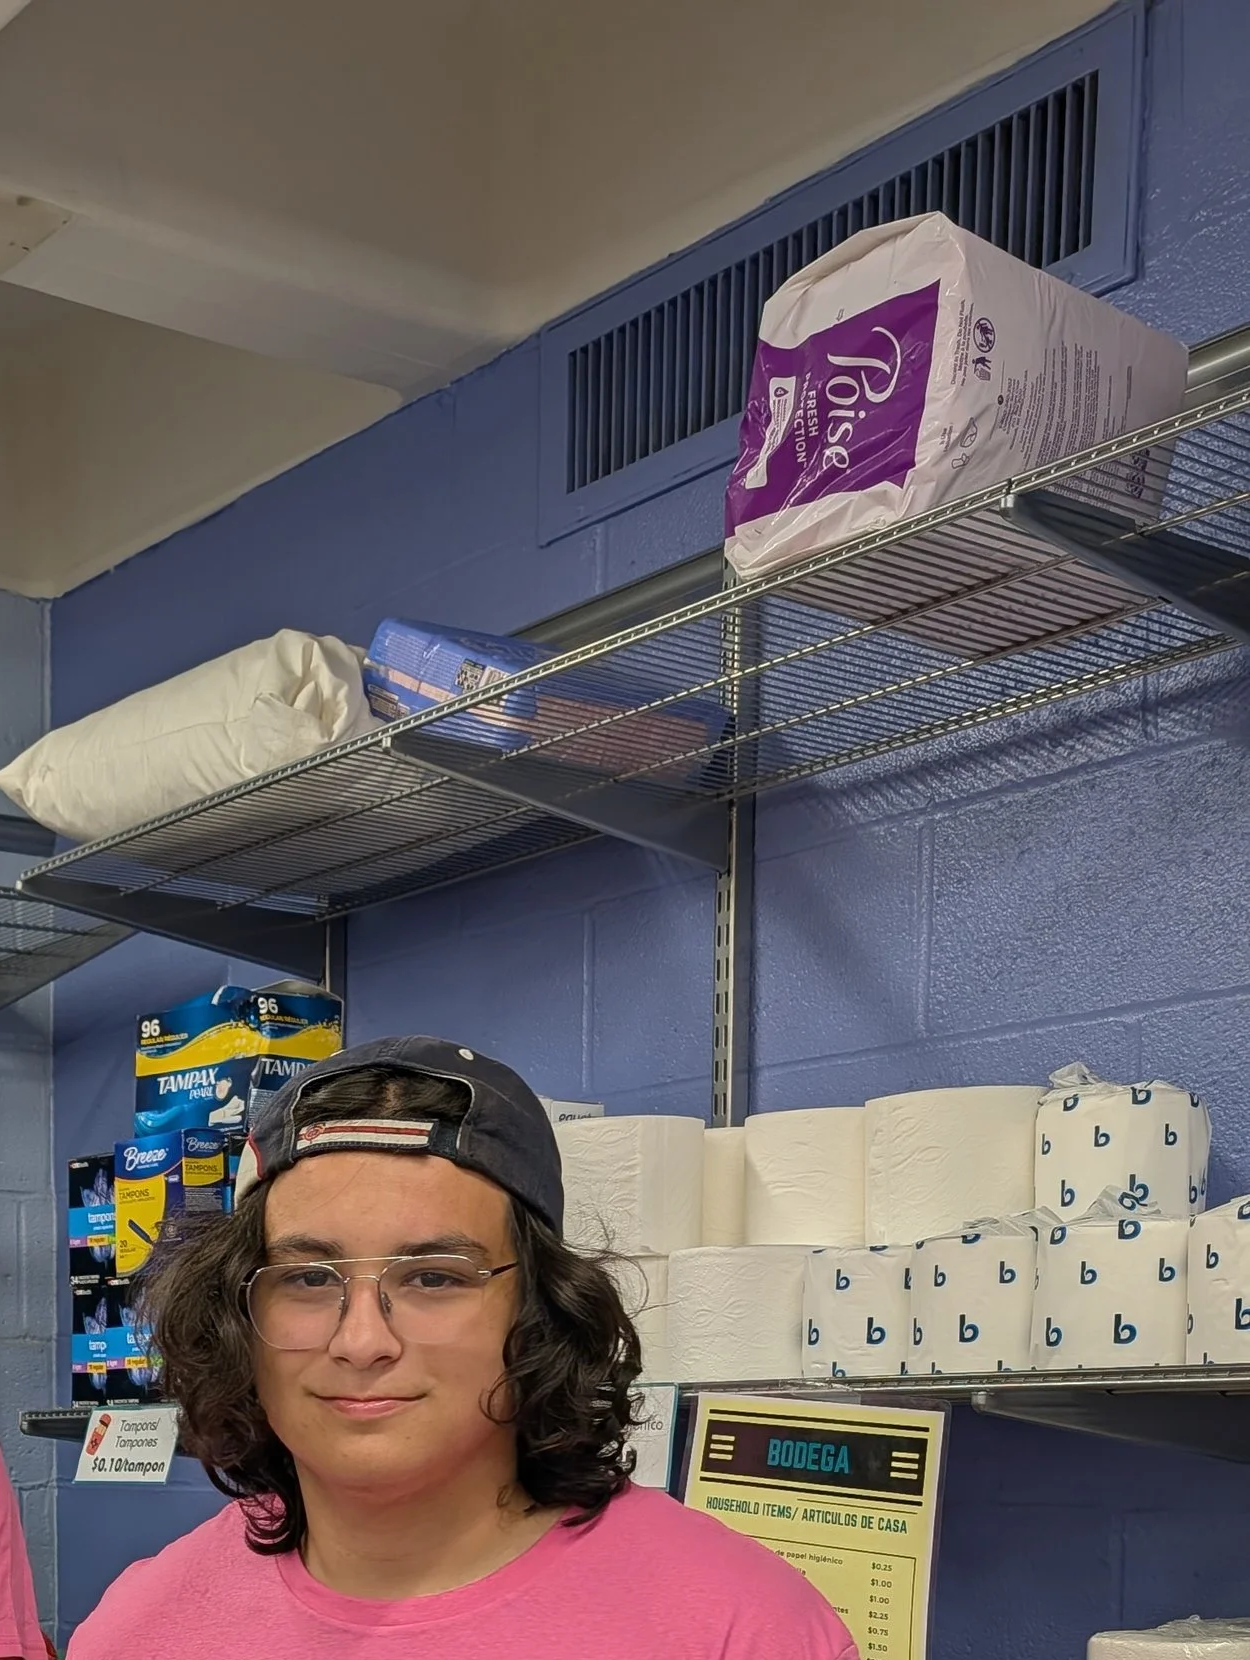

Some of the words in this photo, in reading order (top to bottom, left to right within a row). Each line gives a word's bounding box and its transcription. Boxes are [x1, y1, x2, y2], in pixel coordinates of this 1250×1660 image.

[822, 326, 901, 469] Poise
[807, 390, 819, 437] FRESH
[258, 997, 278, 1015] 96
[141, 1019, 160, 1038] 96
[157, 1067, 219, 1095] TAMPAX
[186, 1136, 220, 1151] Breeze
[1094, 1125, 1110, 1147] b
[1165, 1123, 1178, 1146] b
[124, 1147, 167, 1171] Breeze
[184, 1163, 218, 1173] TAMPONS
[118, 1189, 150, 1200] TAMPONS
[1061, 1179, 1075, 1207] b
[120, 1240, 128, 1248] 20
[1206, 1244, 1219, 1269] b
[836, 1269, 850, 1290] b
[934, 1265, 946, 1287] b
[1159, 1258, 1176, 1282] b
[808, 1319, 820, 1345] b
[1046, 1317, 1062, 1347] b
[1113, 1314, 1137, 1344] b
[120, 1418, 161, 1435] Tampons/
[115, 1436, 158, 1451] Tampones
[766, 1438, 851, 1474] BODEGA
[92, 1457, 165, 1476] $0.10/tampon
[706, 1496, 759, 1516] HOUSEHOLD
[762, 1504, 799, 1521] ITEMS/
[801, 1509, 858, 1528] ARTICULOS
[860, 1515, 874, 1530] DE
[877, 1518, 908, 1535] CASA
[786, 1551, 807, 1560] papel
[808, 1553, 843, 1566] higiénico
[871, 1562, 893, 1572] $0.25
[870, 1578, 892, 1588] $1.00
[869, 1594, 890, 1605] $1.00
[868, 1611, 889, 1621] $2.25
[867, 1626, 889, 1637] $0.75
[868, 1642, 888, 1652] $1.50
